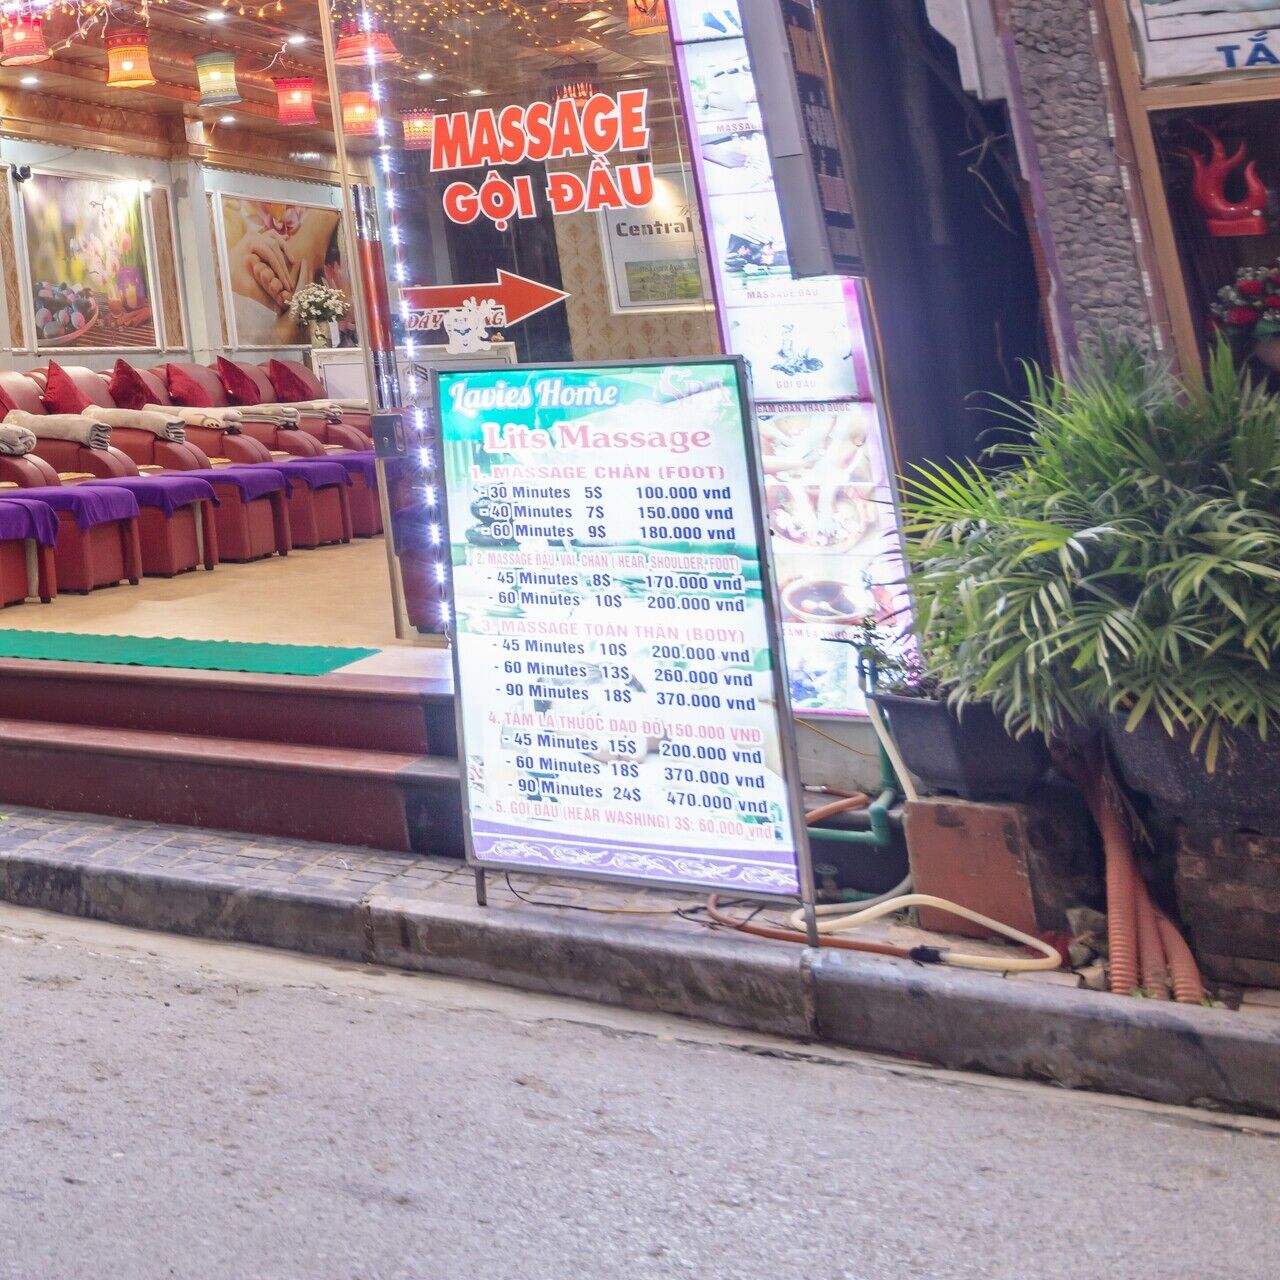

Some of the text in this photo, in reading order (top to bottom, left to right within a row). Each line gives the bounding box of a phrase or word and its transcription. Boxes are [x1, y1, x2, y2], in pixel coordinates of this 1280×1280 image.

[428, 88, 650, 172] MASSAGE
[442, 153, 655, 231] GỘI ĐẦU
[615, 216, 693, 240] Central
[535, 377, 618, 407] Home
[486, 424, 711, 454] Lits Massage
[659, 466, 725, 480] (FOOT)
[490, 486, 731, 500] 30 Minutes 5$ 100.000 vnd
[502, 638, 750, 663] 45 Minutes 10$ 200.000 vnd
